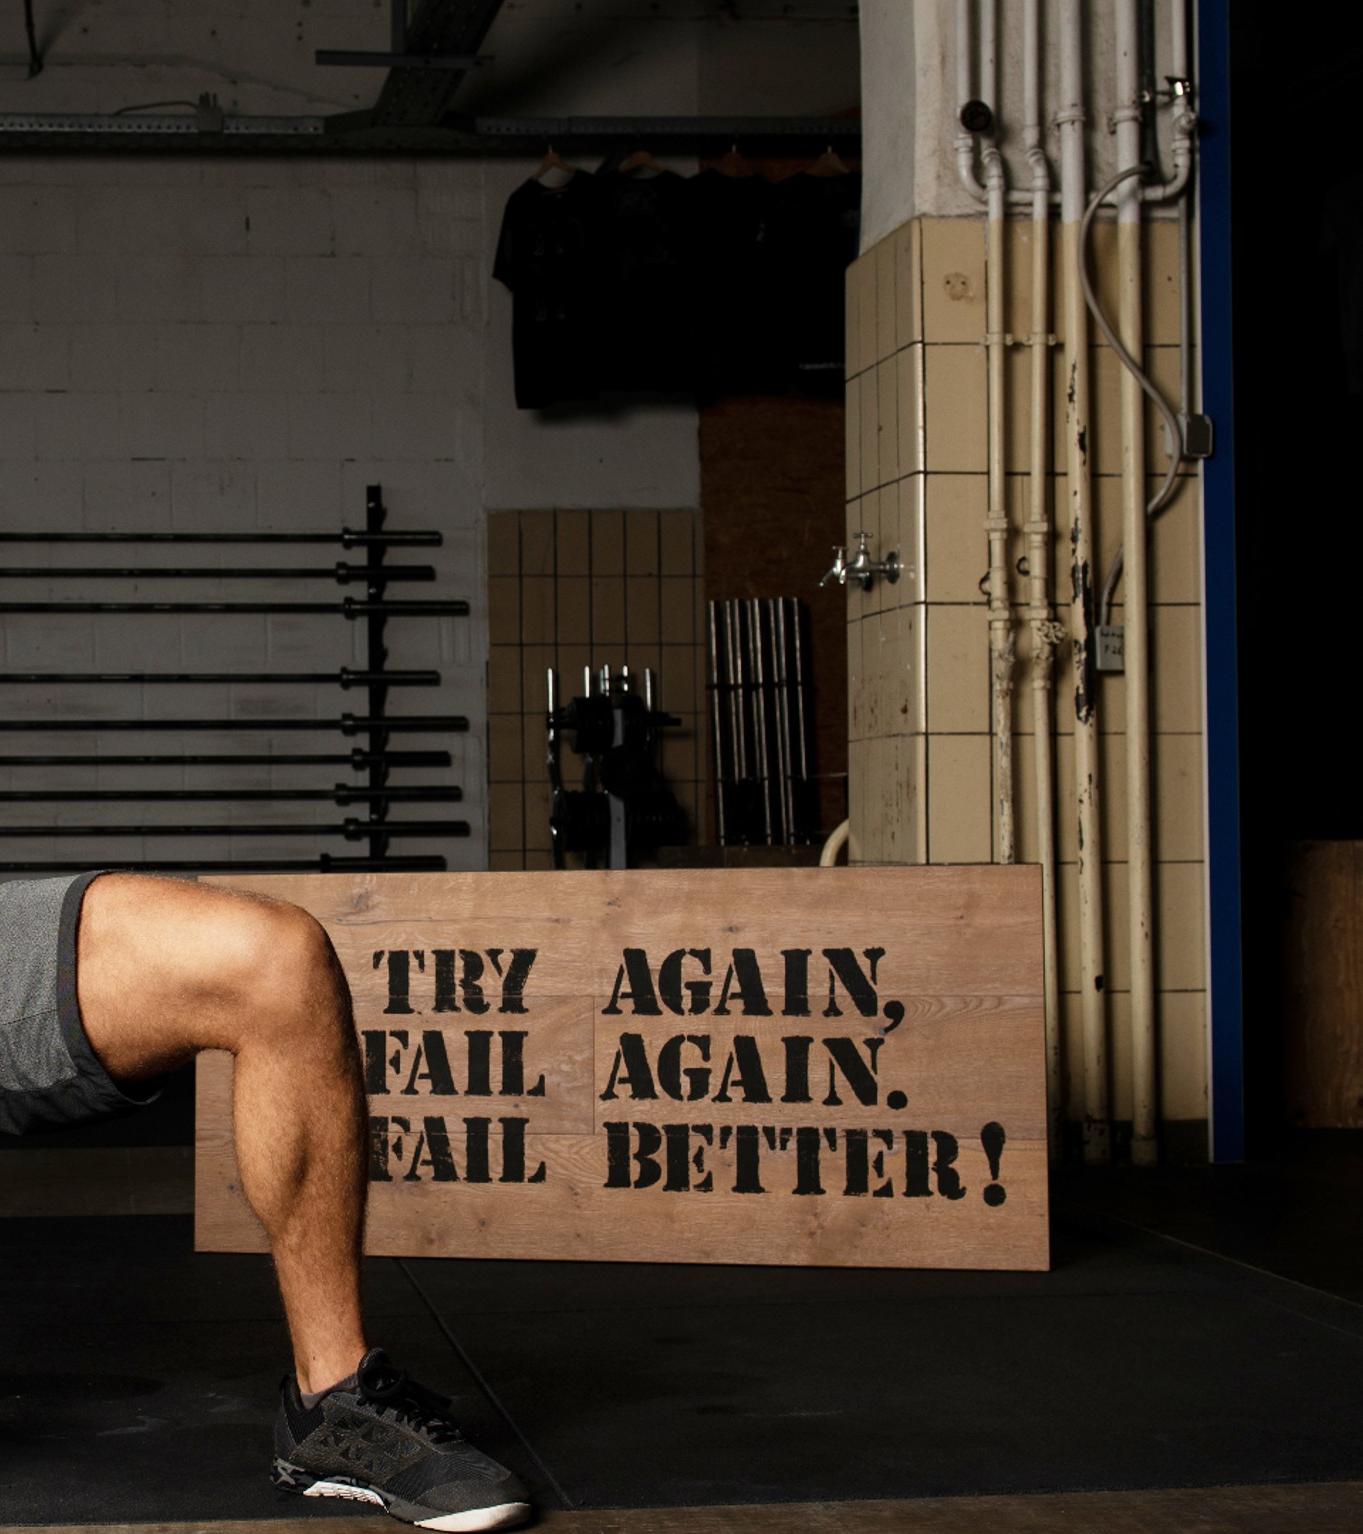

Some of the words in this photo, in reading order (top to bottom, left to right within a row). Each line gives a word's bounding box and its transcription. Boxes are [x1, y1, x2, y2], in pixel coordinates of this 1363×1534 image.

[372, 948, 539, 1015] TRY
[601, 947, 906, 1035] AGAIN,
[361, 1030, 546, 1097] FAIL
[598, 1032, 909, 1111] AGAIN.
[367, 1116, 547, 1184] FAIL
[602, 1121, 1007, 1208] BETTER!
